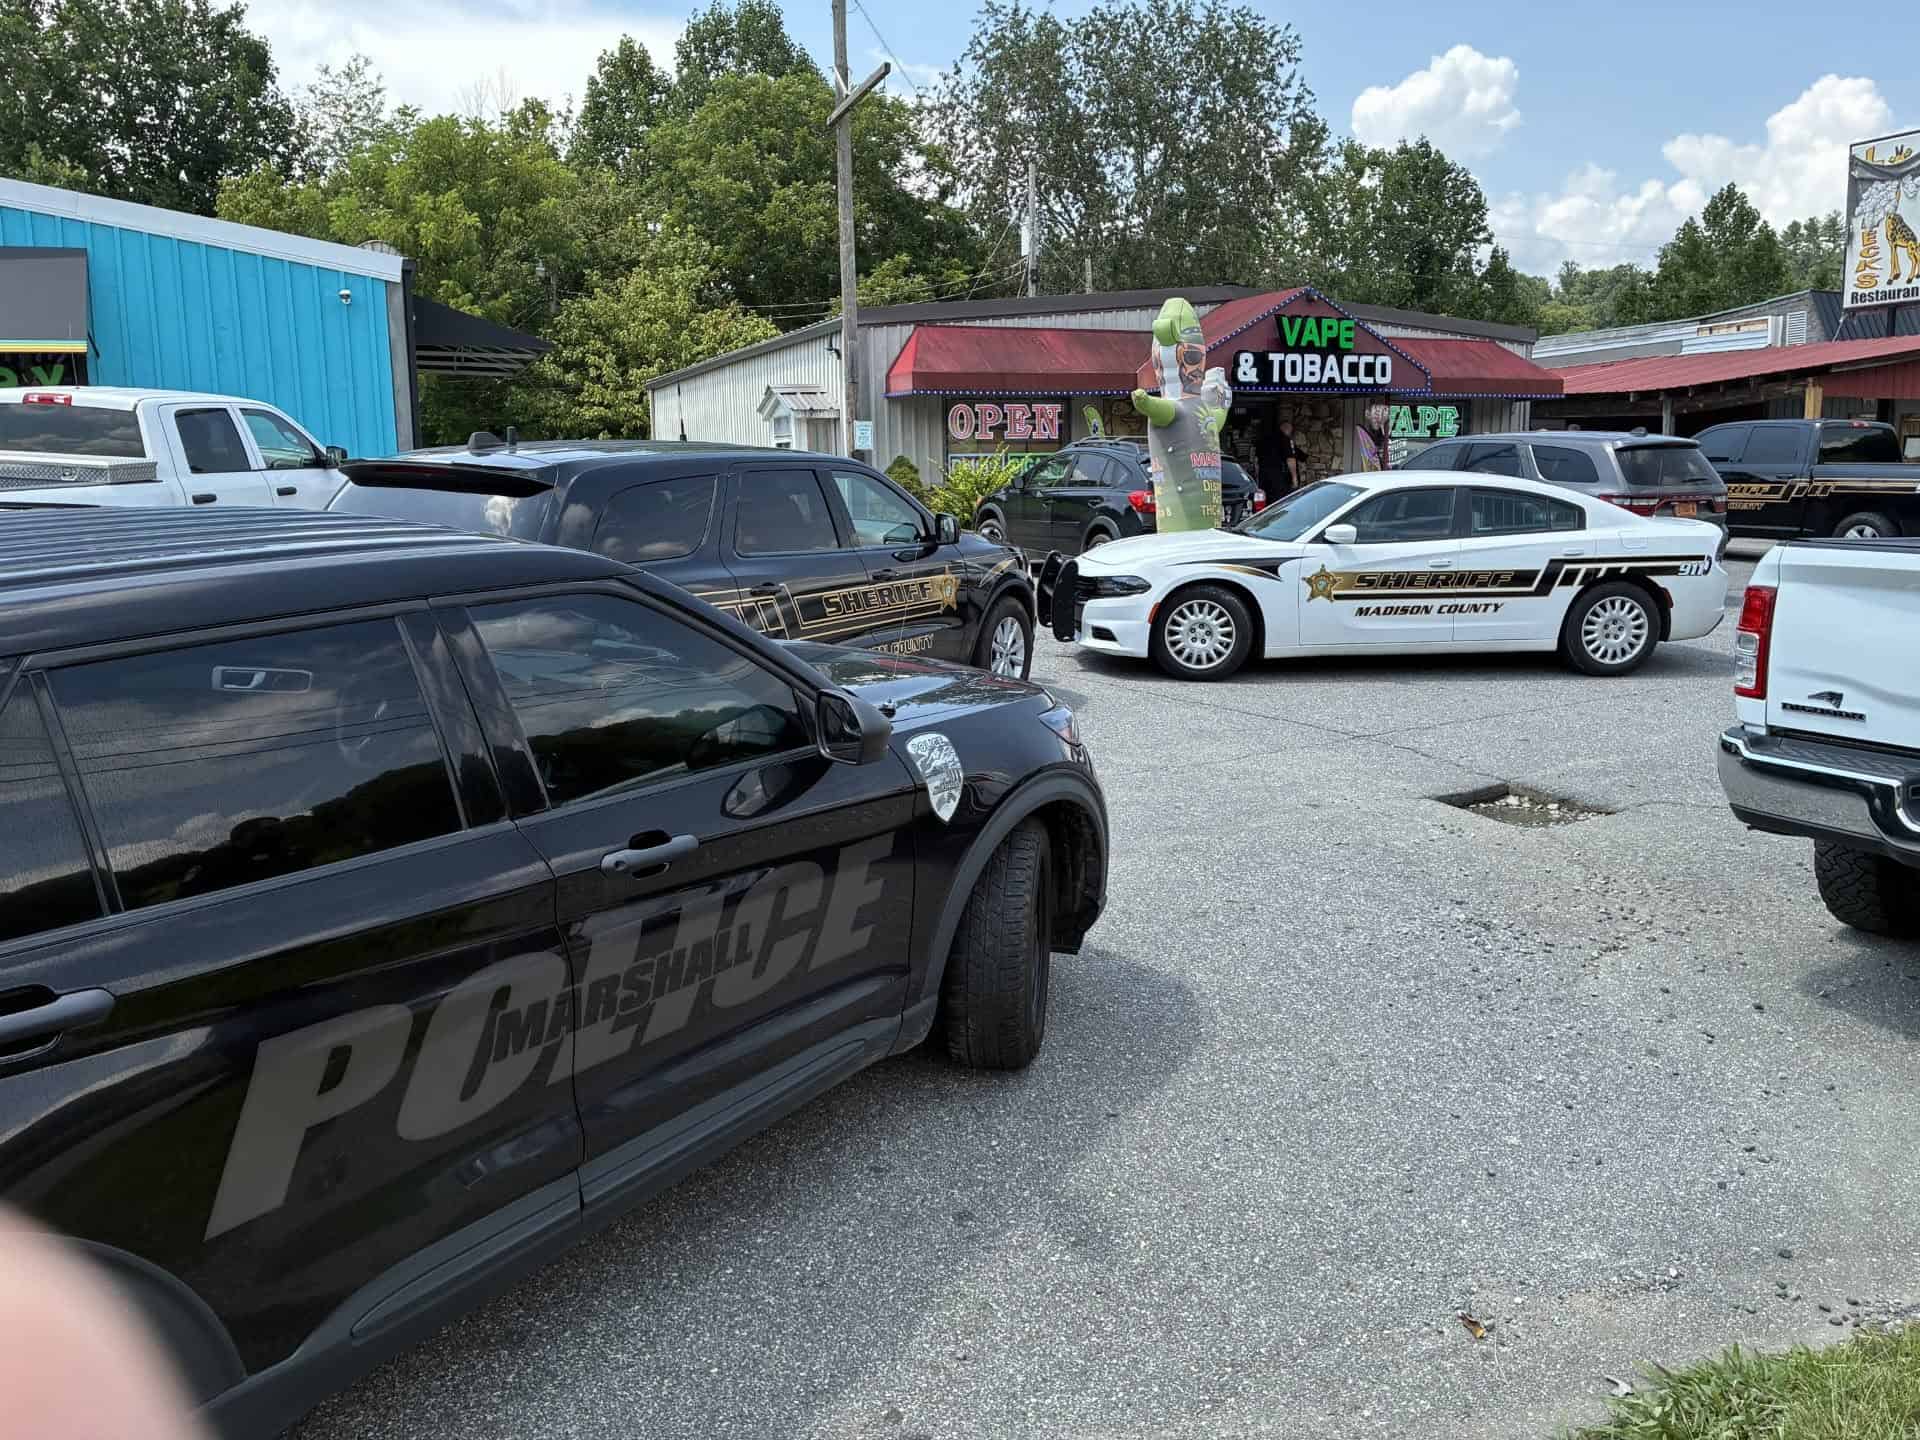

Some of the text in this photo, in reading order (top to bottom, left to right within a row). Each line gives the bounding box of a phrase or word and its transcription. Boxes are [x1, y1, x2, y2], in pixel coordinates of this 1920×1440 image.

[1282, 316, 1355, 348] VAPE
[1237, 353, 1392, 384] & TOBACCO
[949, 403, 1062, 439] OPEN
[1354, 571, 1514, 589] SHERIFF
[822, 581, 934, 617] SHERIFF
[1355, 602, 1504, 617] MADISON COUNTY
[491, 922, 755, 1064] MARSHALL
[203, 833, 896, 1241] POLICE
